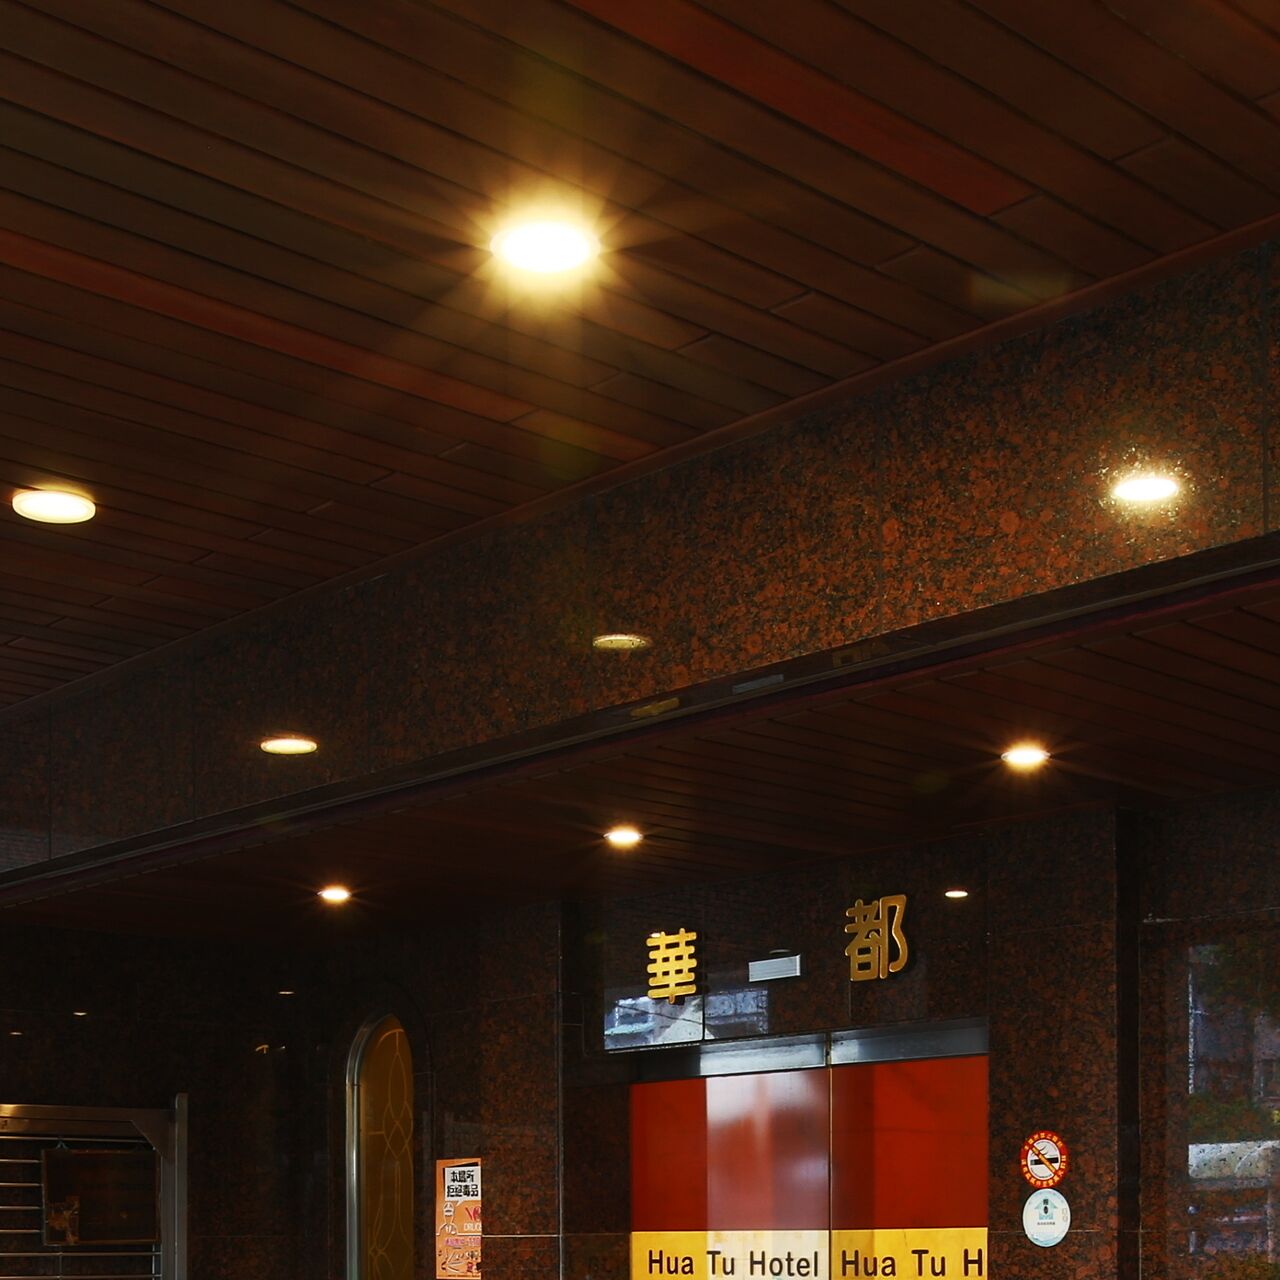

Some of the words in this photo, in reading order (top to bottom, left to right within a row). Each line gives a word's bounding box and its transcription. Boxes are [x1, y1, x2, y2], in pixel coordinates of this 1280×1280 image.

[446, 1183, 479, 1198] 拒絕毒品
[647, 1249, 695, 1276] Hua
[706, 1249, 736, 1276] Tu
[749, 1249, 819, 1278] Hotel
[841, 1249, 897, 1278] Hua
[911, 1248, 947, 1278] Tu
[963, 1247, 984, 1278] H
